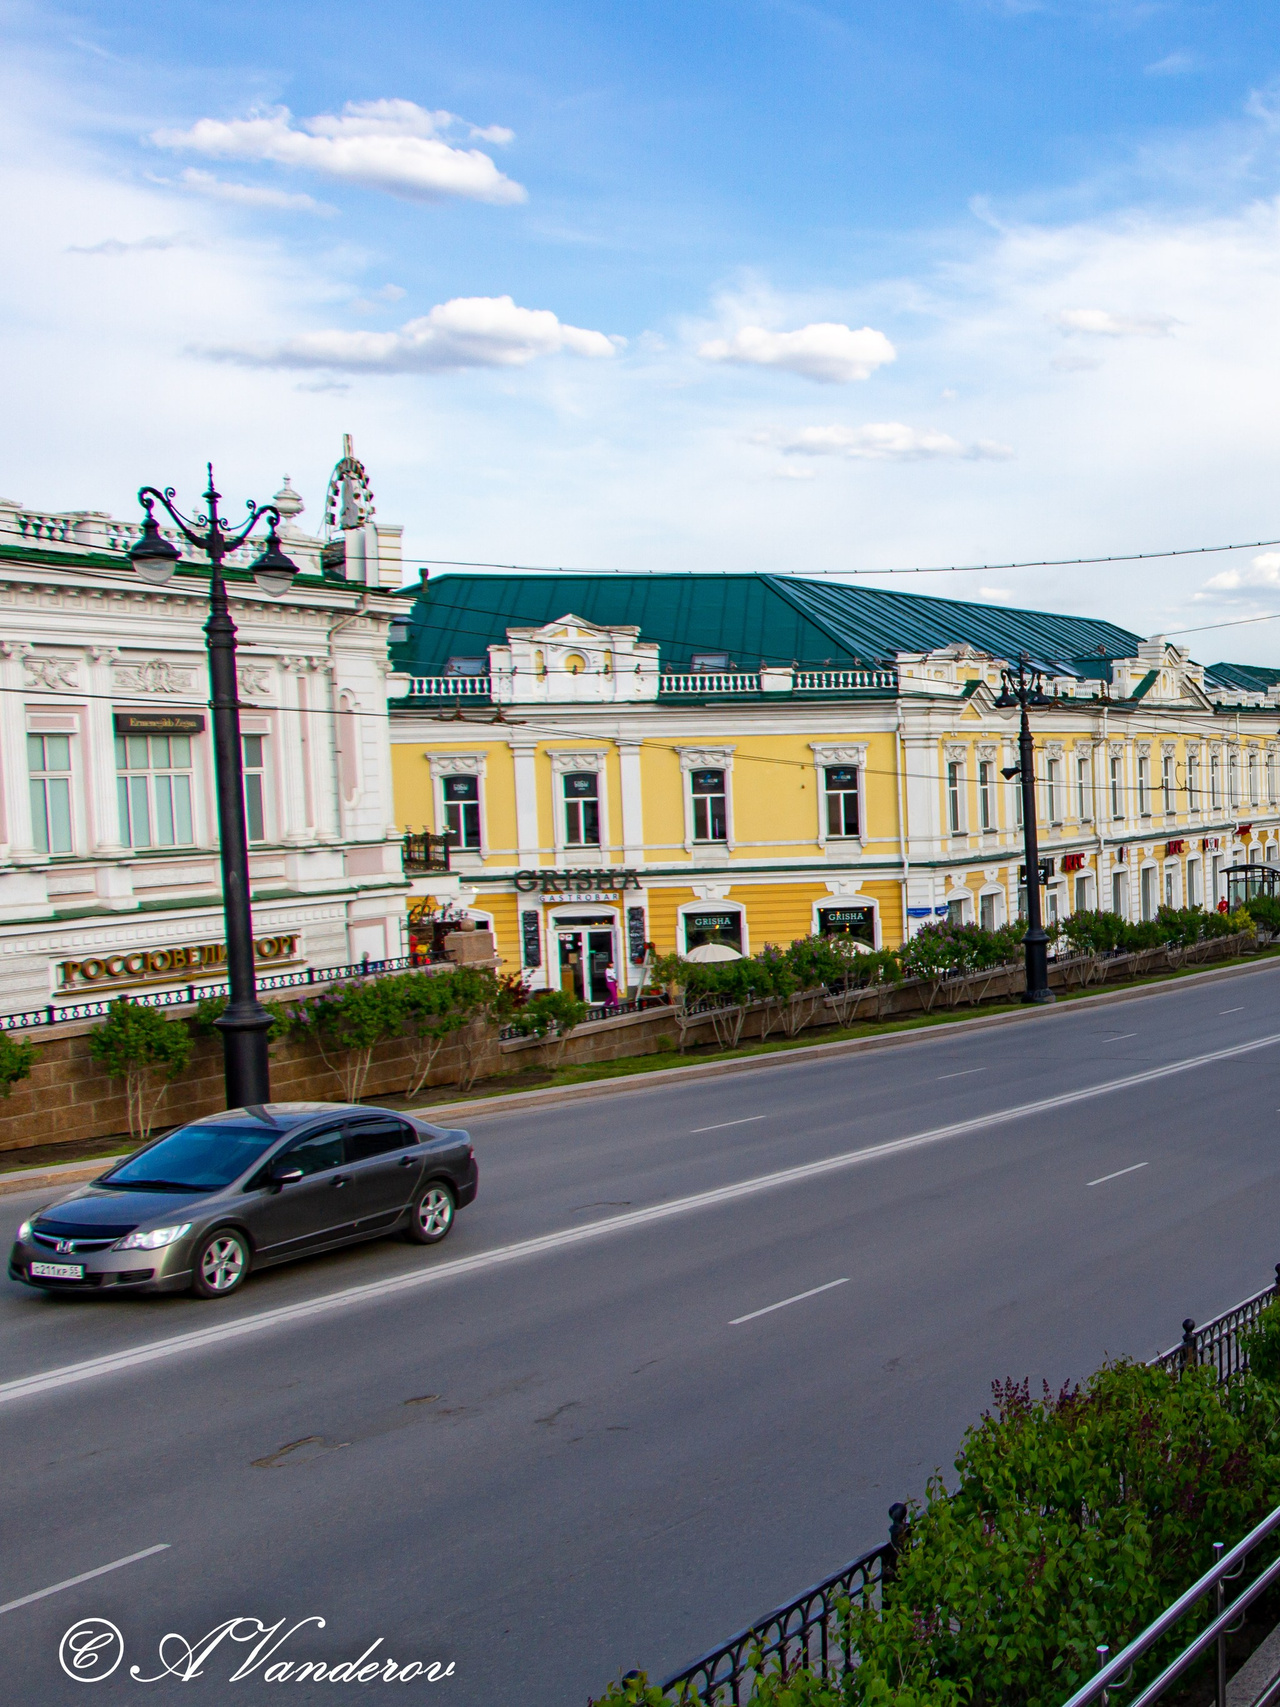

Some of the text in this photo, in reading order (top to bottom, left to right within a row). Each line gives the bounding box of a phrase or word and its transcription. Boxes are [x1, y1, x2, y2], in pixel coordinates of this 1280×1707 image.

[1167, 839, 1185, 856] KFC
[1065, 852, 1085, 872] KFC
[513, 868, 643, 893] GRISHA
[539, 893, 619, 903] GASTROBAR
[694, 917, 731, 926] GRISHA
[828, 912, 864, 921] GRISHA
[61, 933, 302, 983] РОССЮВЕЛИОРГ
